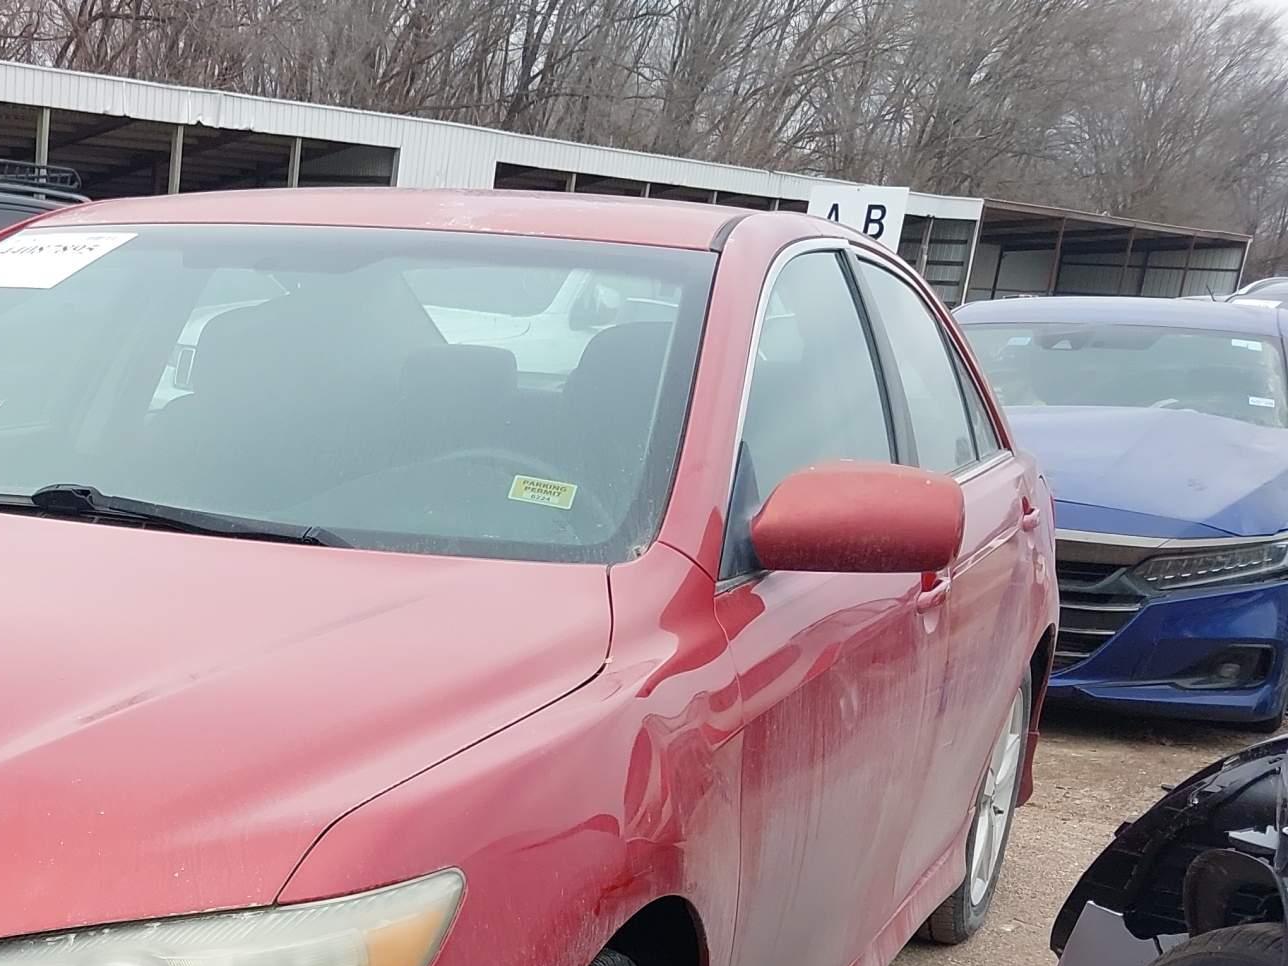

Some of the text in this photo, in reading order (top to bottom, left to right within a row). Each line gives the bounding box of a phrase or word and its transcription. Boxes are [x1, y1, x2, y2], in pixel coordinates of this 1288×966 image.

[862, 204, 887, 241] B
[523, 480, 567, 492] PARKING
[524, 486, 561, 497] PERMIT
